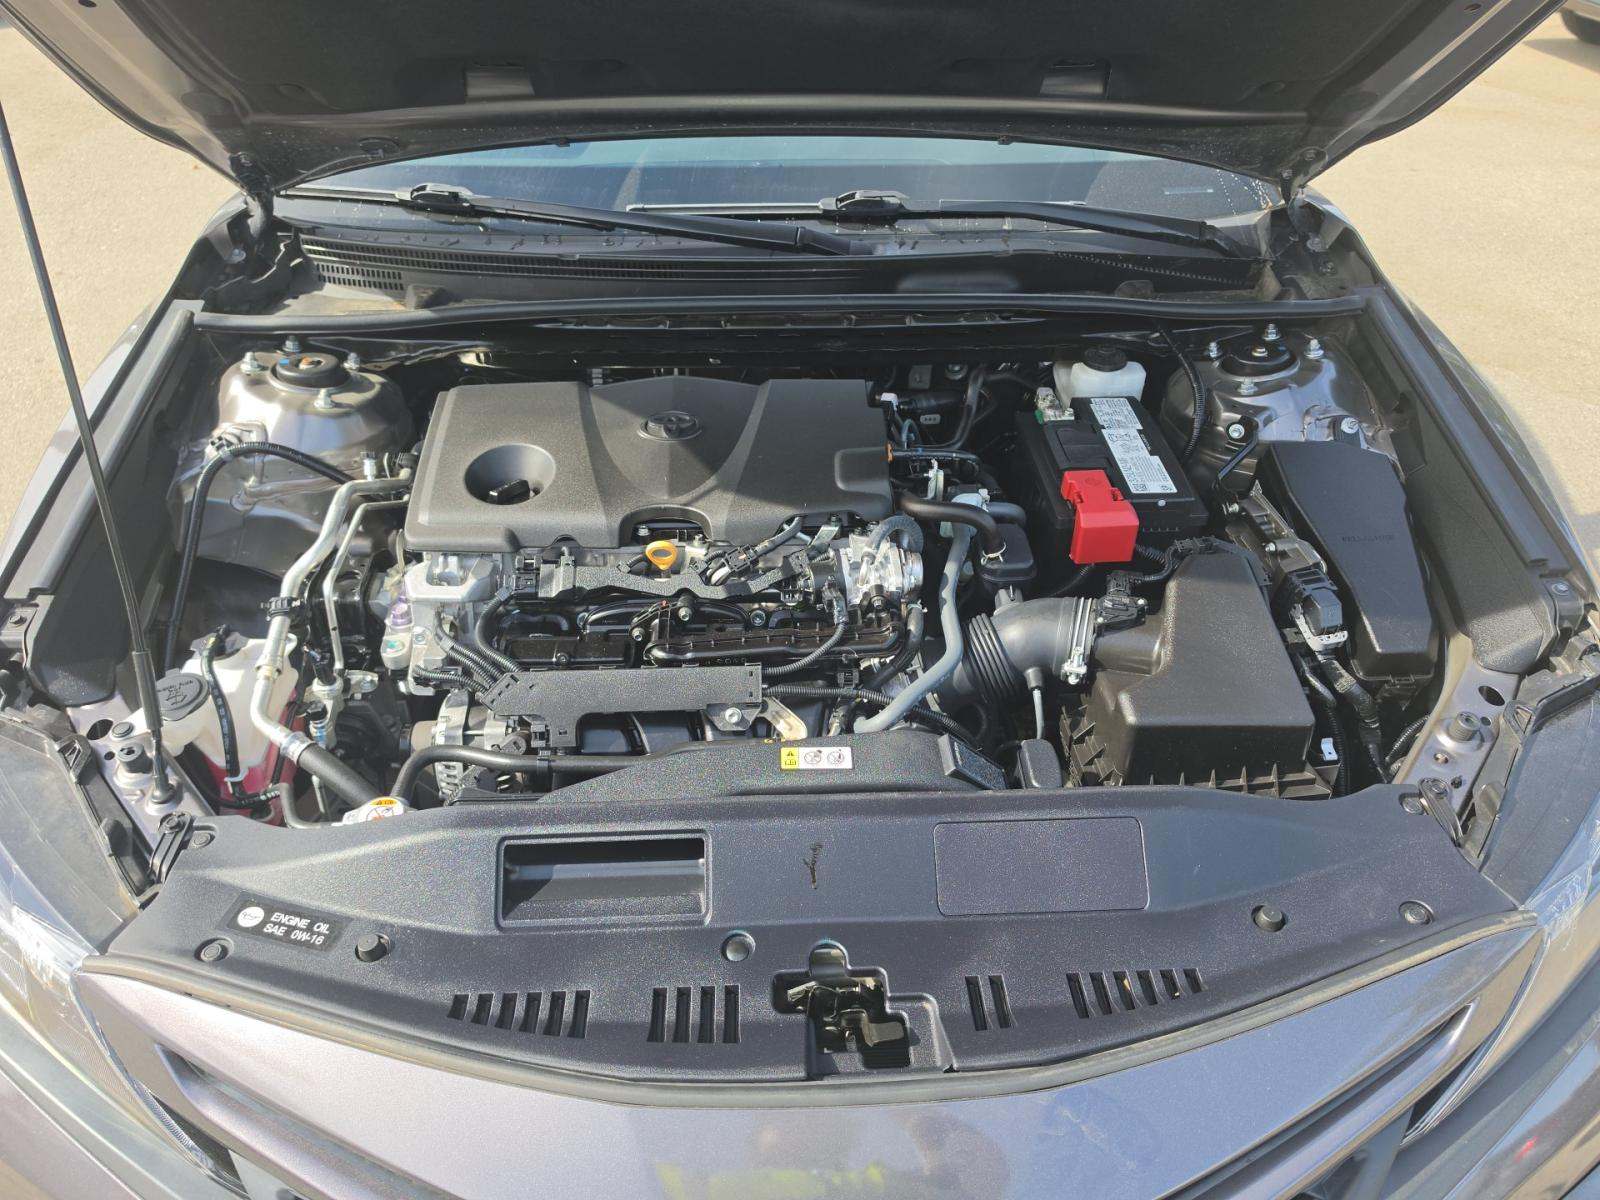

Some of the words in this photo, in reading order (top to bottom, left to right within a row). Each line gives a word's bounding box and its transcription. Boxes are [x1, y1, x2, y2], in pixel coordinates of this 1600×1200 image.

[263, 923, 287, 936] SAE
[290, 929, 325, 945] 0W-16
[270, 912, 311, 929] ENGINE
[313, 922, 330, 934] OIL
